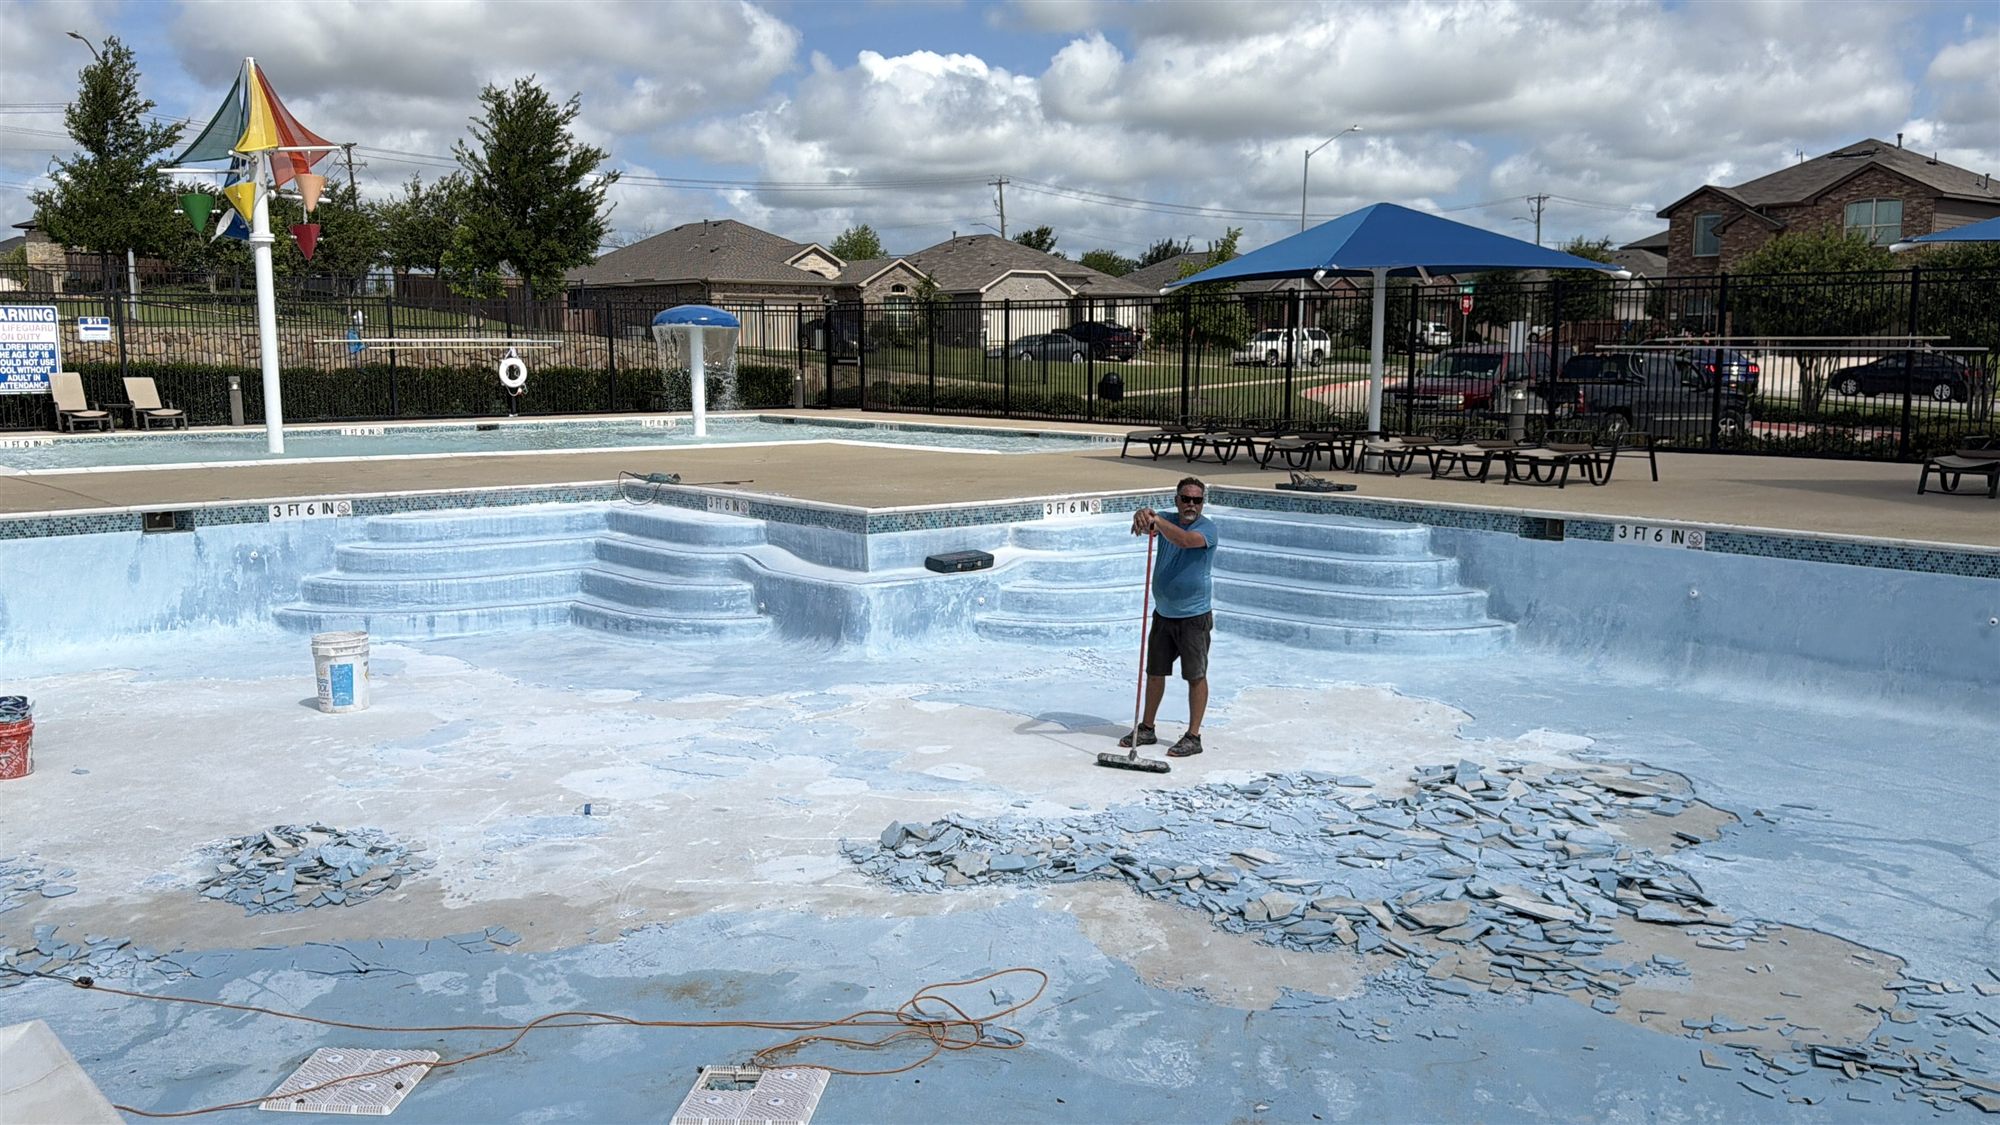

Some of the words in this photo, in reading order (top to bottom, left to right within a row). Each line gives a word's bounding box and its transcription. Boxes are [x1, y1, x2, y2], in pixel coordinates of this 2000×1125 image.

[2, 323, 53, 332] LIFEGUARD
[16, 333, 41, 341] DUTY
[17, 366, 51, 374] WITHOUT
[273, 505, 281, 517] 3
[288, 504, 300, 516] FT
[307, 504, 315, 515] 6
[322, 502, 334, 514] IN
[725, 500, 729, 510] 6
[1046, 503, 1053, 515] 3
[1057, 502, 1065, 514] FT
[1070, 502, 1076, 513] 6
[1080, 501, 1089, 512] IN
[1618, 525, 1627, 538] 3
[1634, 526, 1648, 540] FT
[1654, 529, 1663, 542] 6
[1671, 529, 1684, 544] IN
